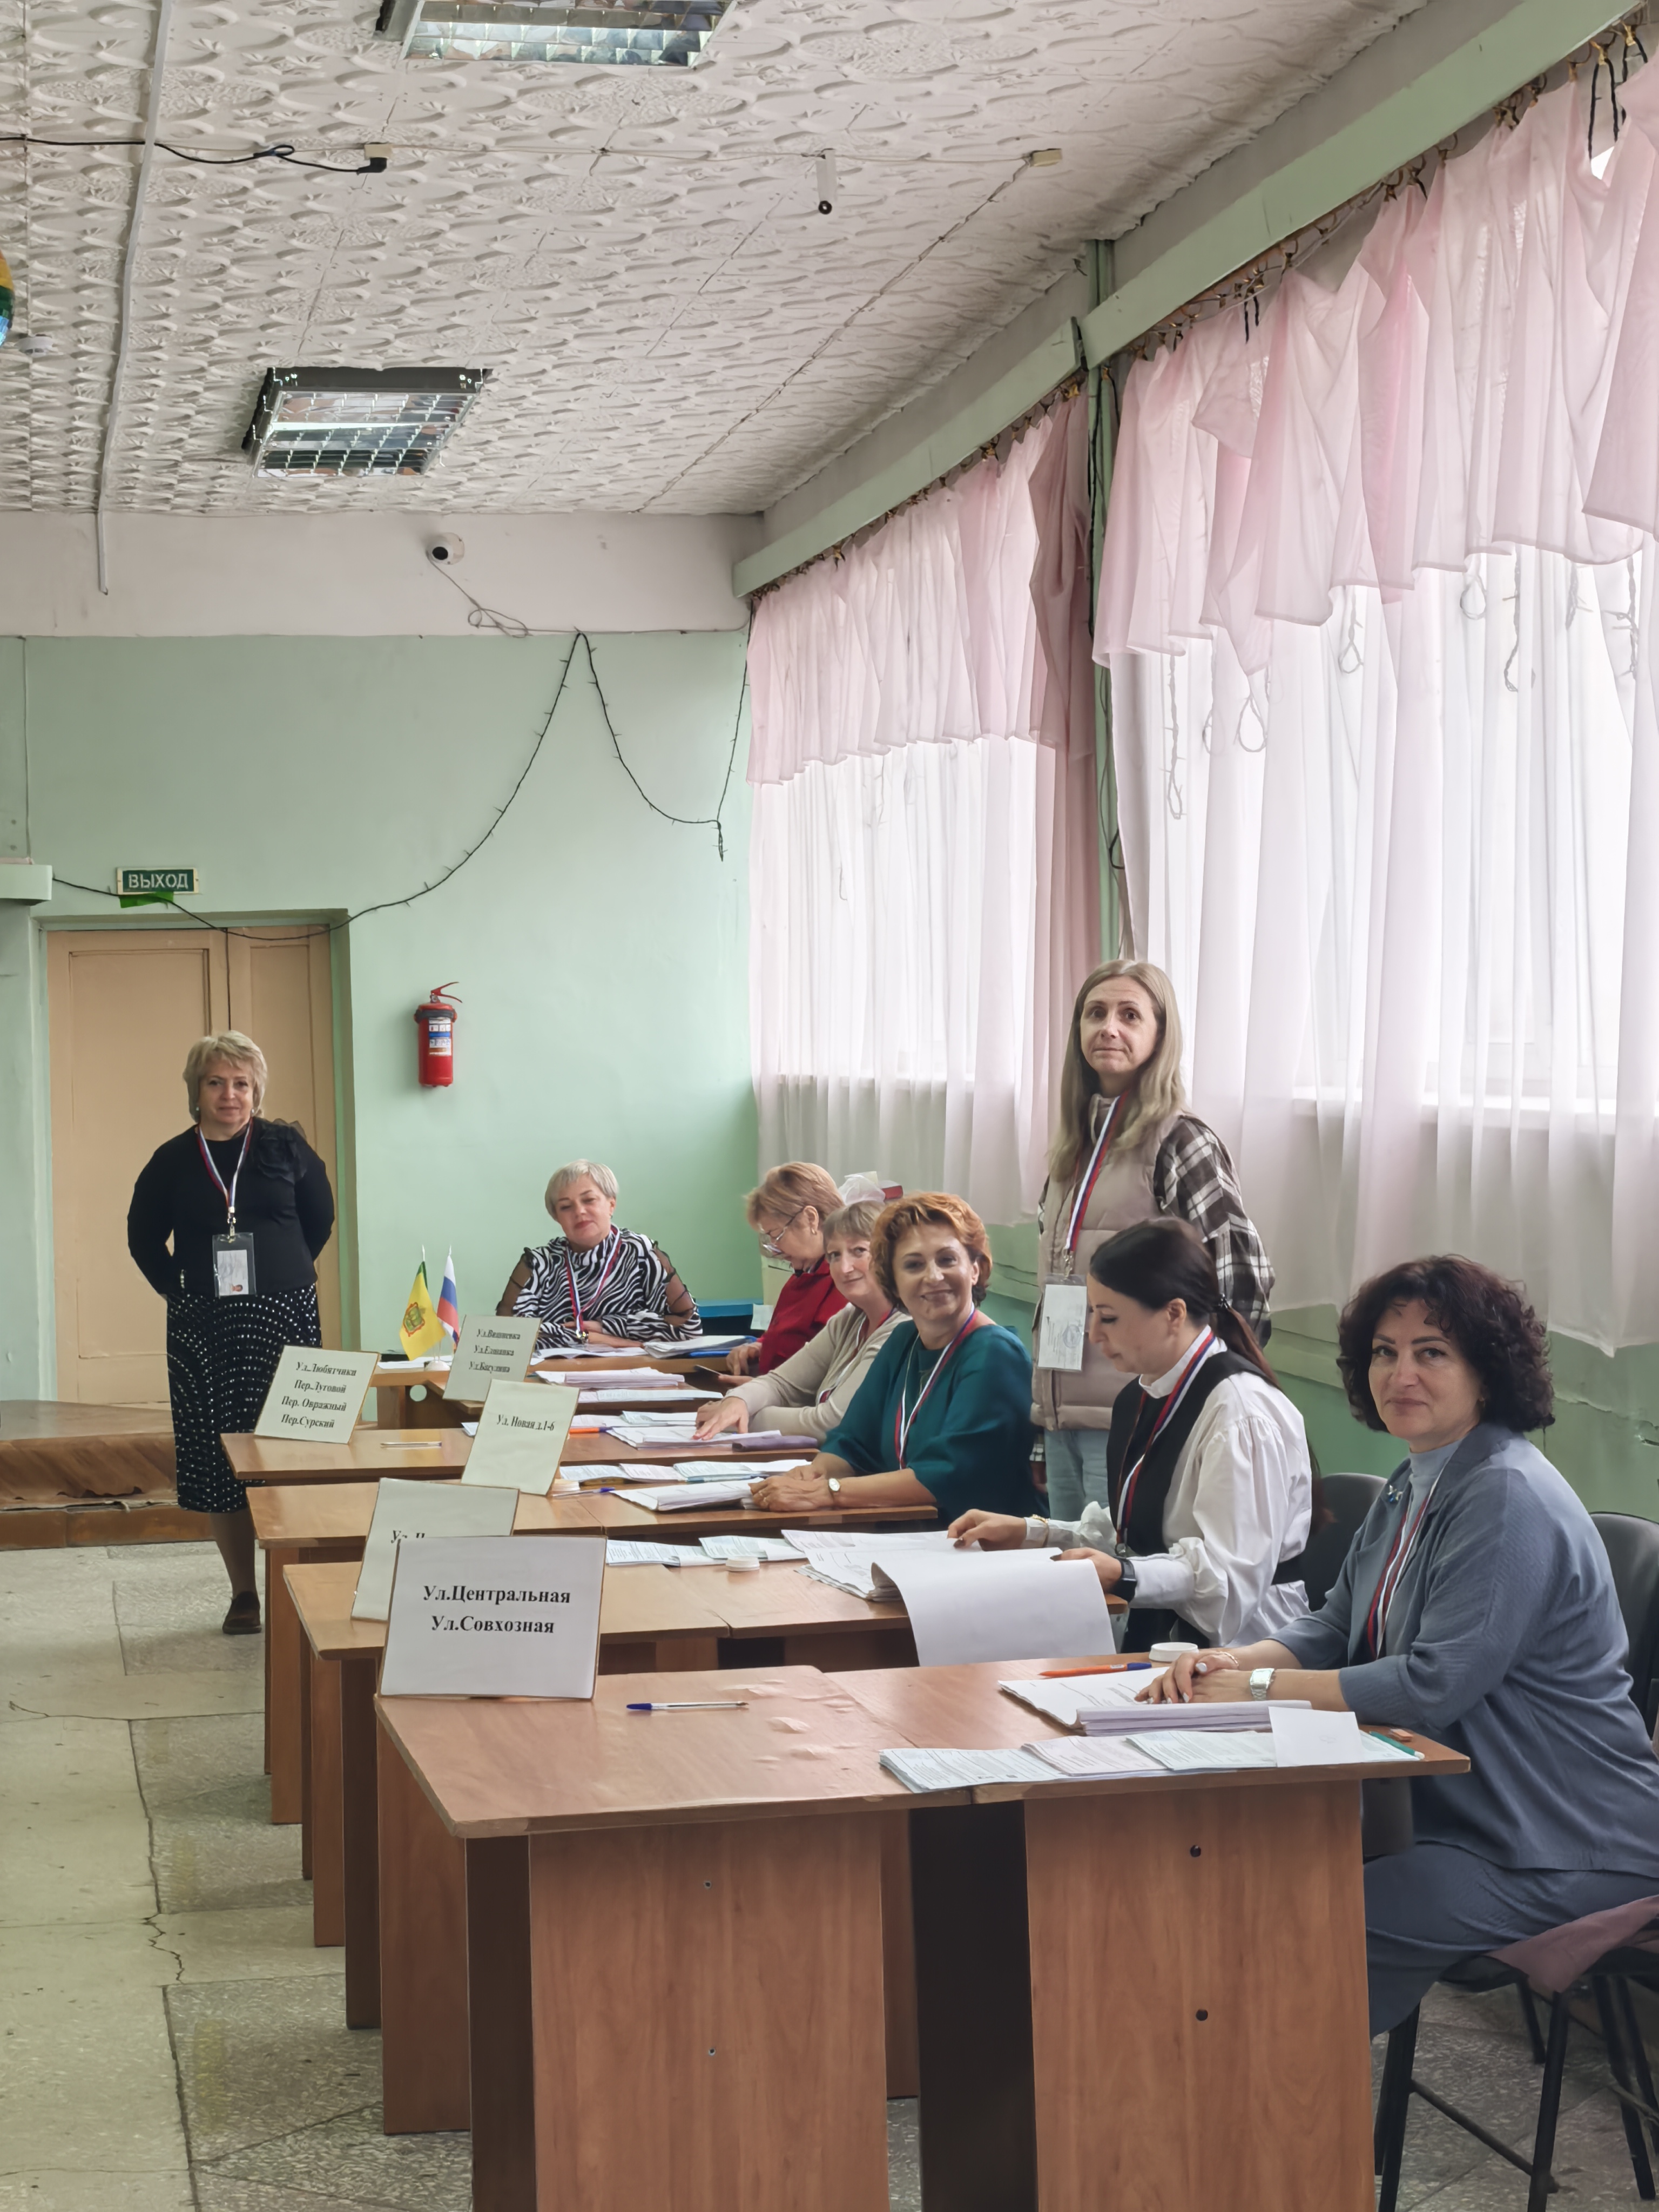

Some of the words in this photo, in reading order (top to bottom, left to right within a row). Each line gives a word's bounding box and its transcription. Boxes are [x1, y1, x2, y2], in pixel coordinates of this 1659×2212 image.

[129, 873, 188, 889] ВЫХОД
[302, 1398, 347, 1412] Овражный
[511, 1415, 536, 1429] Новая
[423, 1585, 571, 1605] Ул.Центральная
[431, 1615, 555, 1633] Ул.Совхозная
